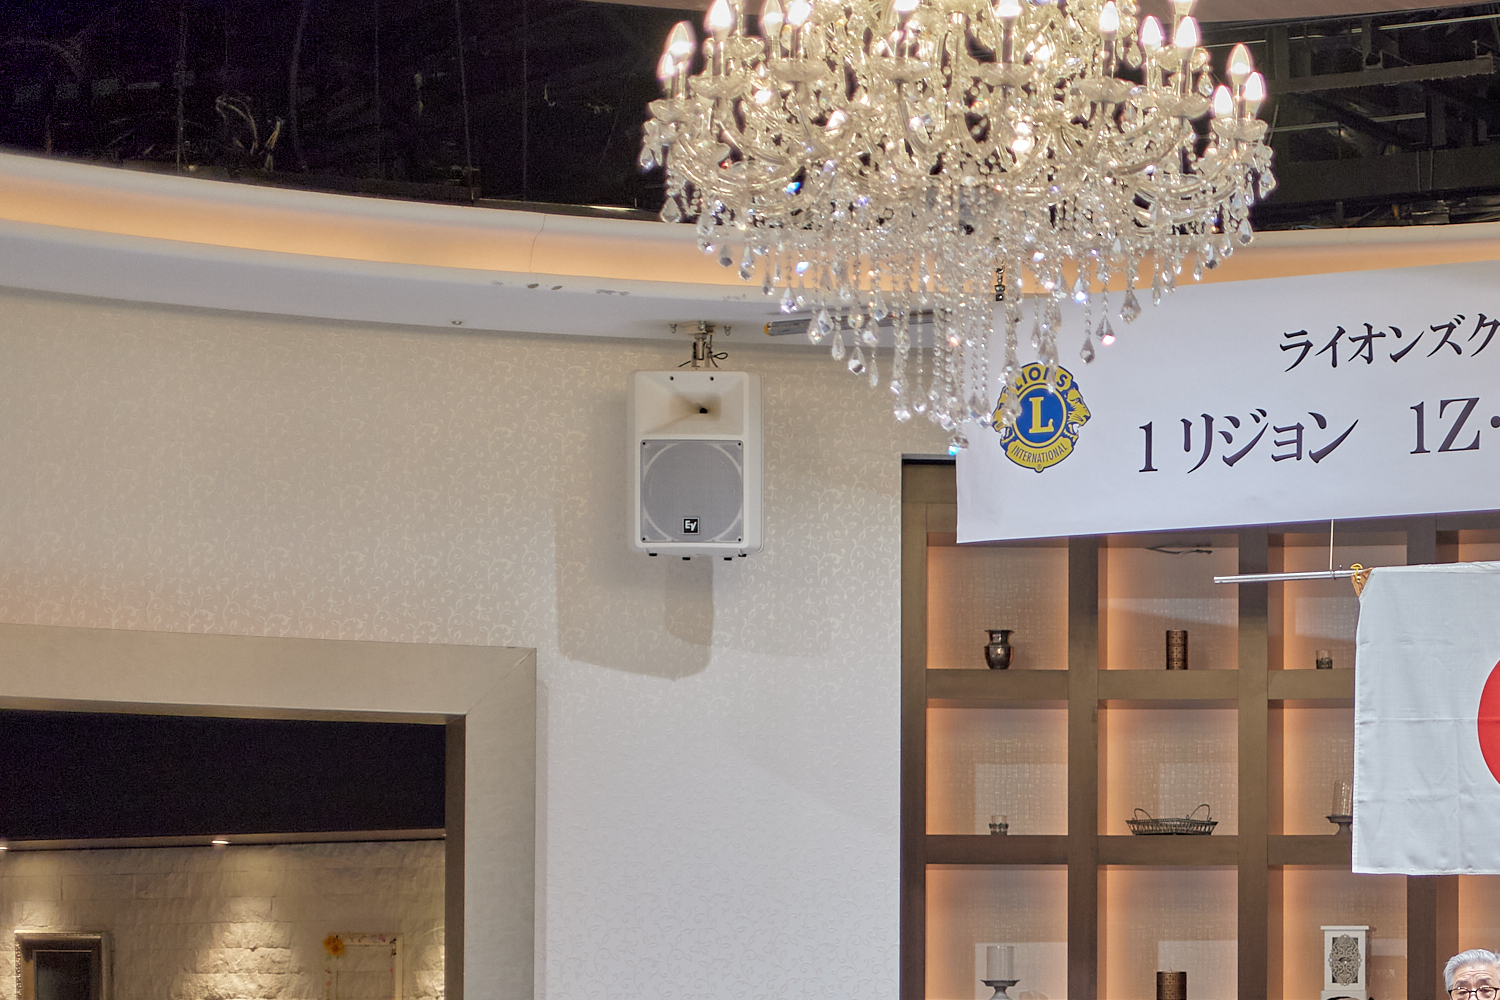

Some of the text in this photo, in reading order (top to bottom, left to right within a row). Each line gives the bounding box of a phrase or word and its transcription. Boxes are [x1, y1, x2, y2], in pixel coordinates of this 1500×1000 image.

[1028, 396, 1055, 434] L
[1011, 443, 1068, 463] INTERNATIONAL
[1180, 408, 1360, 475] リジョン
